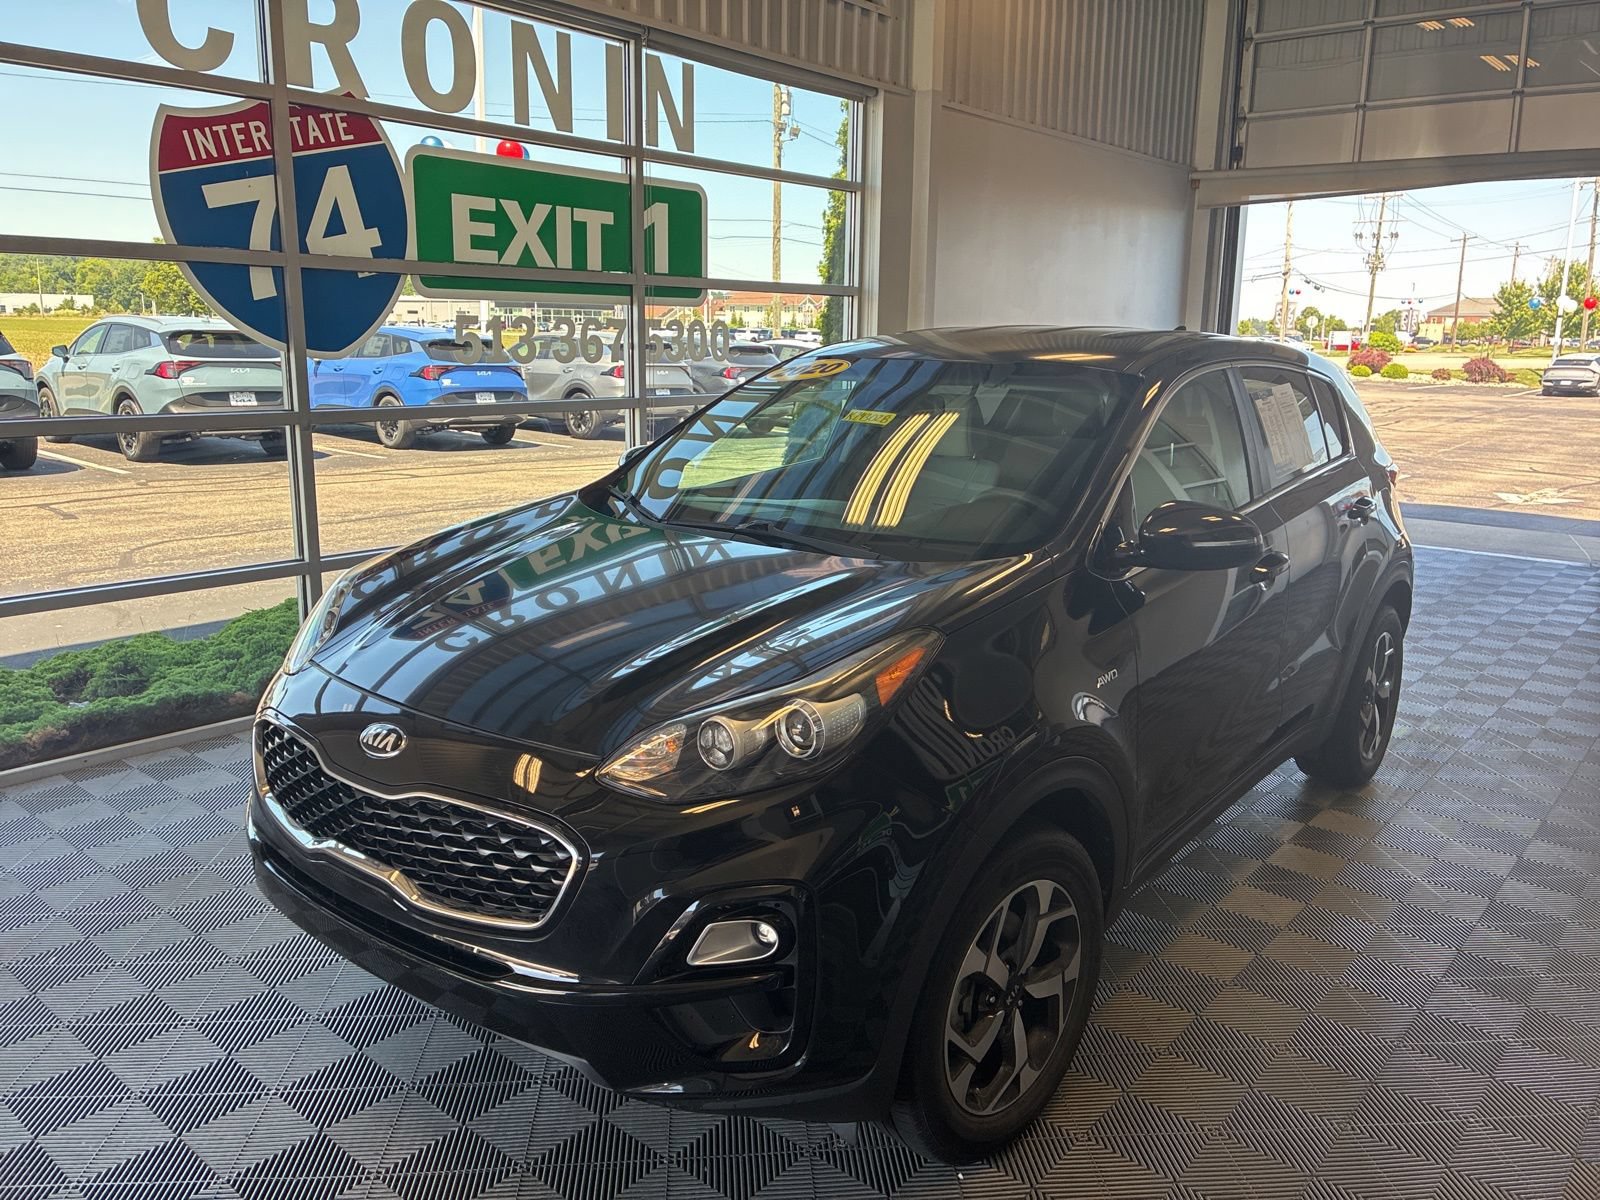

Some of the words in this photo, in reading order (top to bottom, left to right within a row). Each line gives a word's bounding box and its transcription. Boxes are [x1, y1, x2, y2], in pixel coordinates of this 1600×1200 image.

[136, 0, 695, 154] CRONIN
[182, 113, 354, 161] INTERTATE
[201, 165, 382, 300] 74
[451, 193, 614, 271] EXIT
[644, 202, 669, 274] 1
[1097, 668, 1118, 689] AWD
[362, 728, 398, 752] KIA
